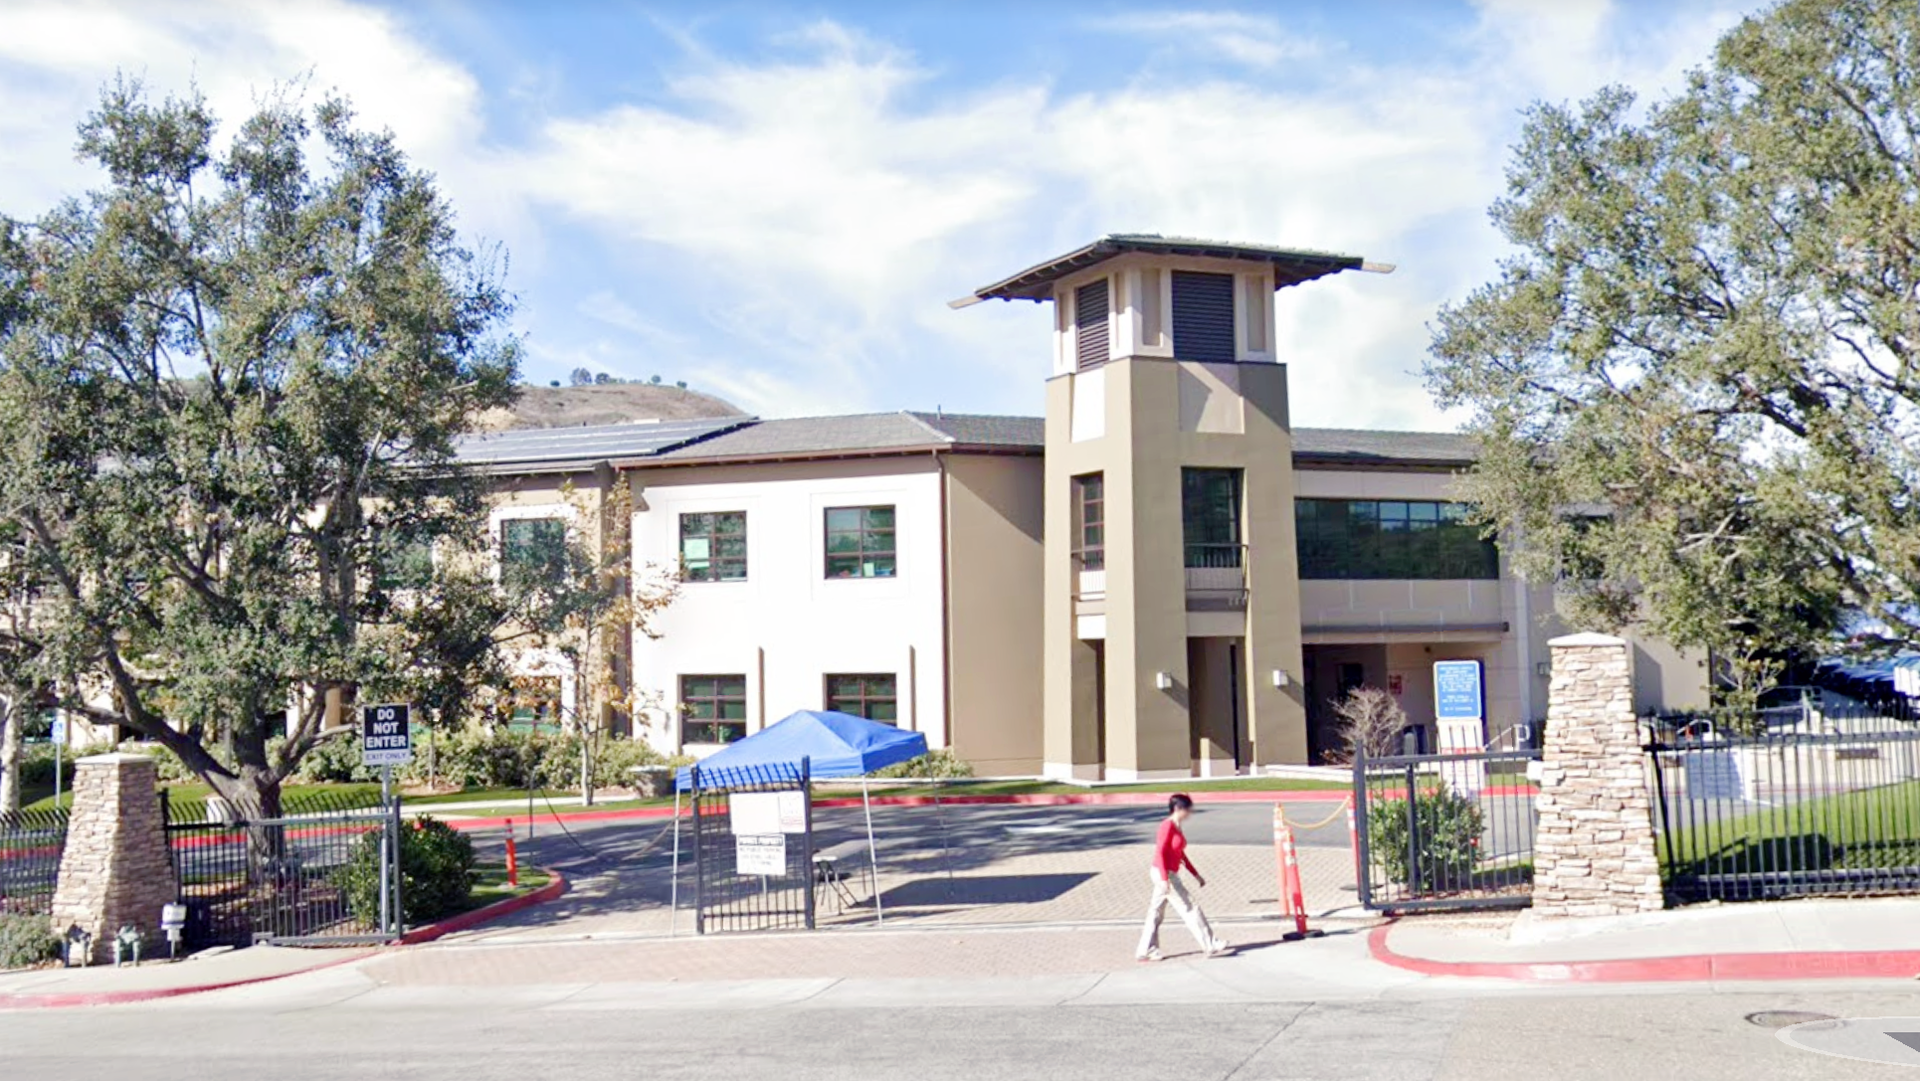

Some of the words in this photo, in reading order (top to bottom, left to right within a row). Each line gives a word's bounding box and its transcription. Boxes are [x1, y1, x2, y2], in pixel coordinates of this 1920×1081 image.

[377, 708, 395, 720] DO
[373, 722, 399, 735] NOT
[366, 735, 406, 748] ENTER
[366, 752, 383, 760] EXIT
[385, 752, 406, 760] ONLY
